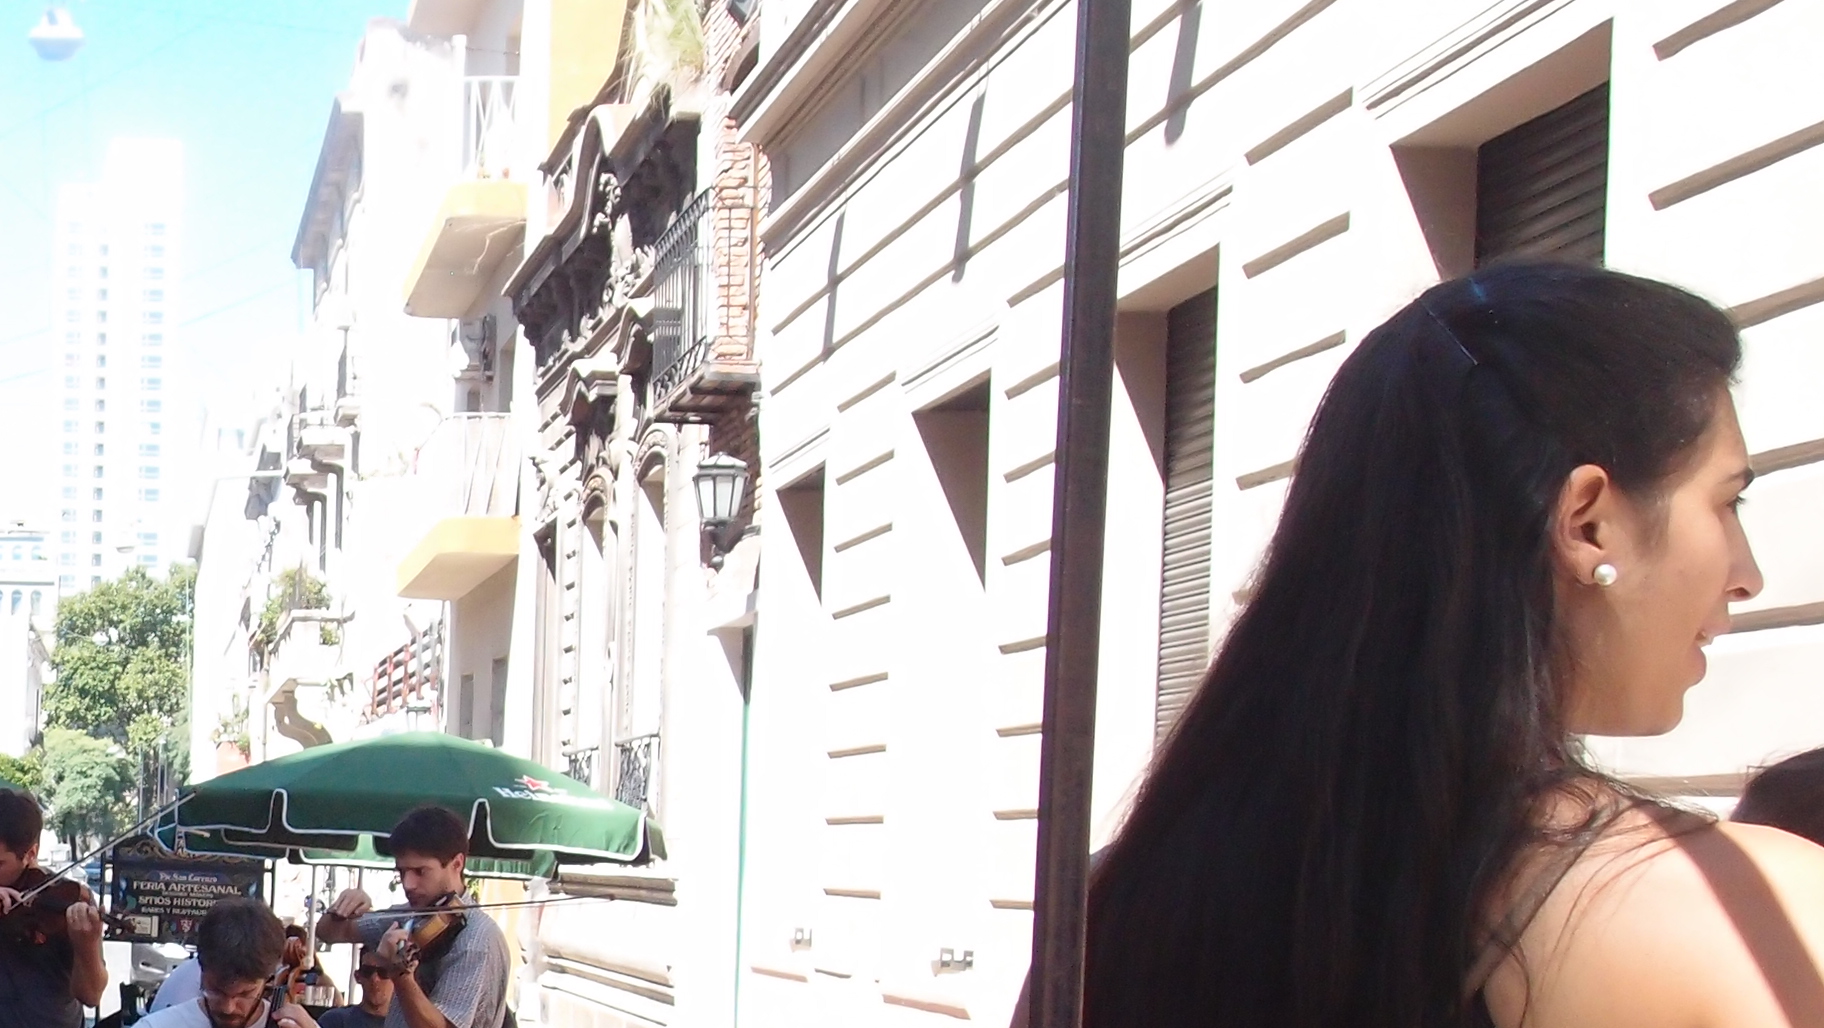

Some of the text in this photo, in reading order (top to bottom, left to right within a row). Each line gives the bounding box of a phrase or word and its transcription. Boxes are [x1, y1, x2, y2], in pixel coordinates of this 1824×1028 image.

[133, 880, 166, 891] FERIA
[168, 882, 242, 896] ARTESANAL
[138, 895, 172, 906] SITIOS
